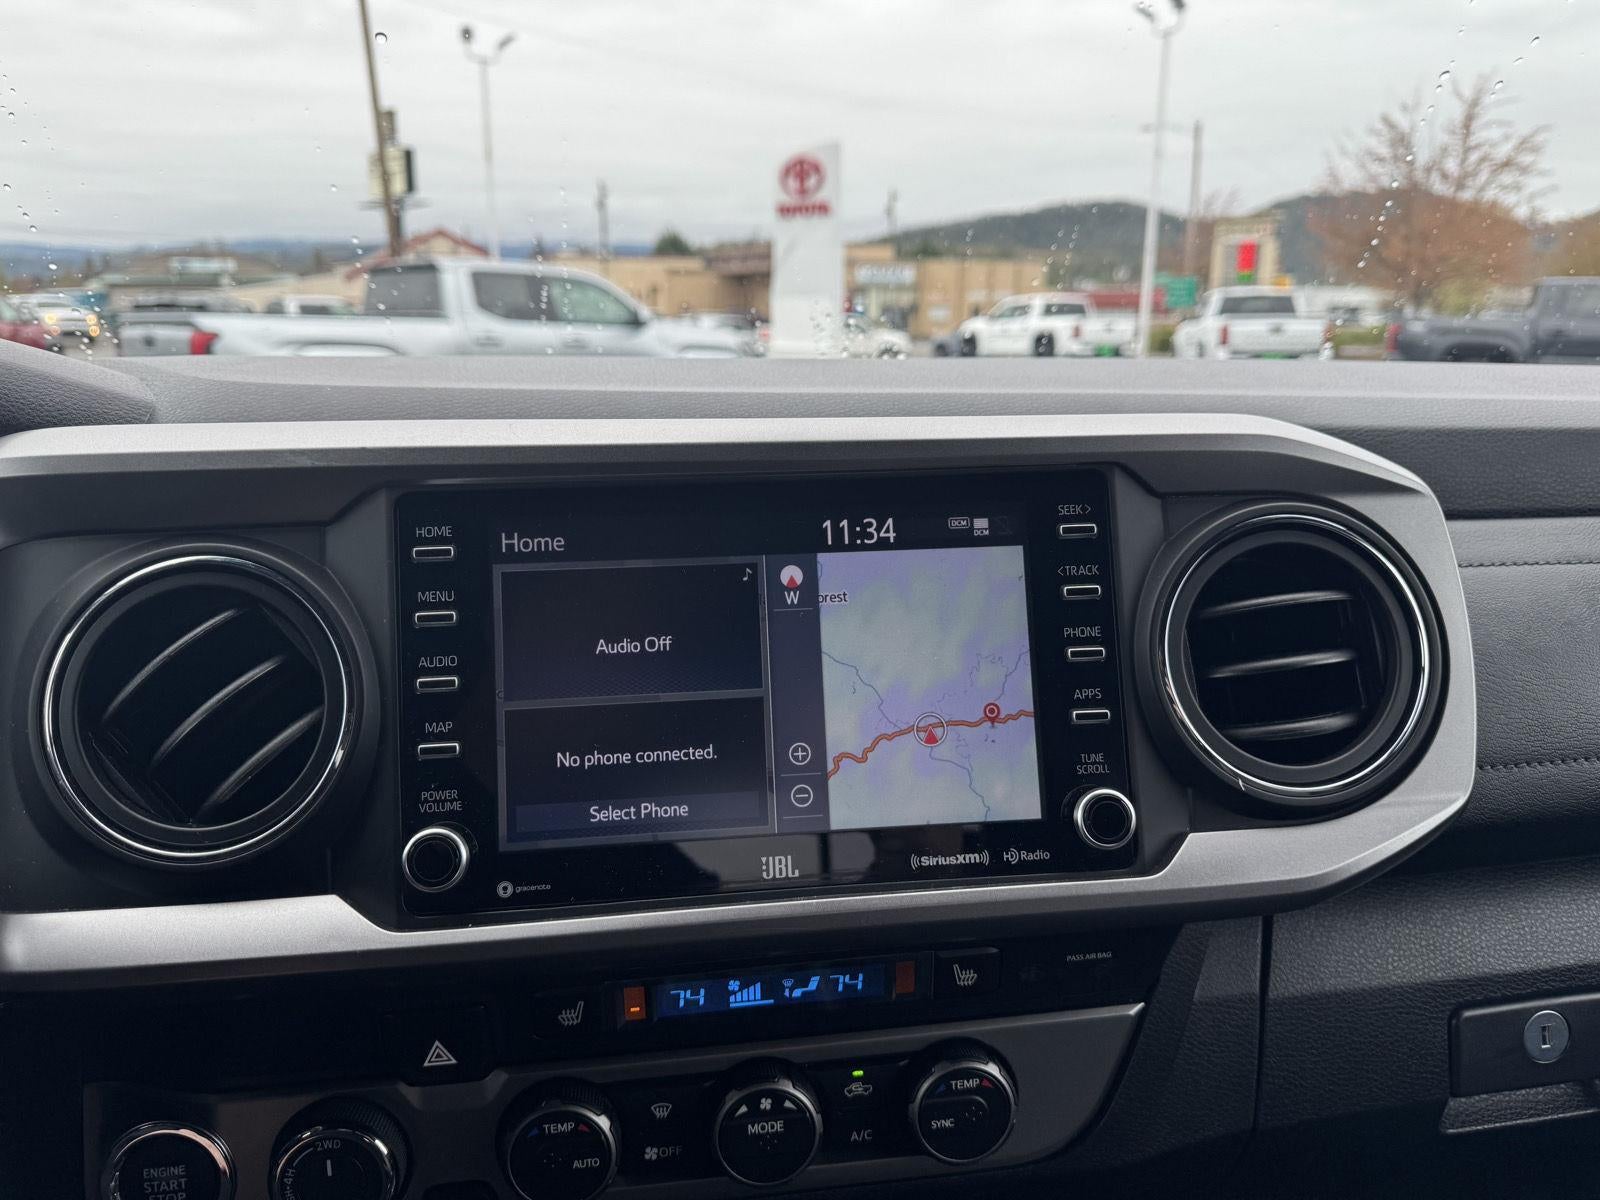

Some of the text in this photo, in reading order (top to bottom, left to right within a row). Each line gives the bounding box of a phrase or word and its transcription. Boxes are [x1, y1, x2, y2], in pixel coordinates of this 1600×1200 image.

[951, 519, 967, 527] DCM
[415, 526, 453, 538] HOME
[822, 517, 897, 546] 11:34
[501, 532, 565, 553] Home
[417, 590, 455, 602] MENU
[784, 590, 800, 605] W
[1063, 625, 1102, 638] PHONE
[595, 635, 673, 655] Audio Off
[418, 655, 458, 668] AUDIO
[1073, 688, 1103, 700] APPS
[424, 721, 454, 734] MAP
[556, 743, 719, 770] No phone connected.
[1079, 752, 1105, 763] TUNE
[1076, 763, 1111, 775] SCROLL
[421, 789, 459, 802] POWER
[418, 800, 464, 813] VOLUME
[589, 802, 690, 822] Select Phone
[1020, 848, 1051, 861] Radio
[761, 854, 800, 880] JBL
[1066, 954, 1085, 962] PASS
[1084, 952, 1097, 961] AIR
[829, 972, 864, 993] 74
[669, 987, 706, 1009] 74
[950, 1077, 981, 1091] TEMP
[542, 1121, 576, 1136] TEMP
[748, 1119, 786, 1136] MODE
[931, 1118, 956, 1130] SYNC
[850, 1129, 873, 1143] A/C
[315, 1138, 342, 1152] 2WD
[658, 1145, 684, 1159] OFF
[572, 1157, 600, 1169] AUTO
[143, 1164, 187, 1179] ENGINE
[143, 1177, 189, 1194] START
